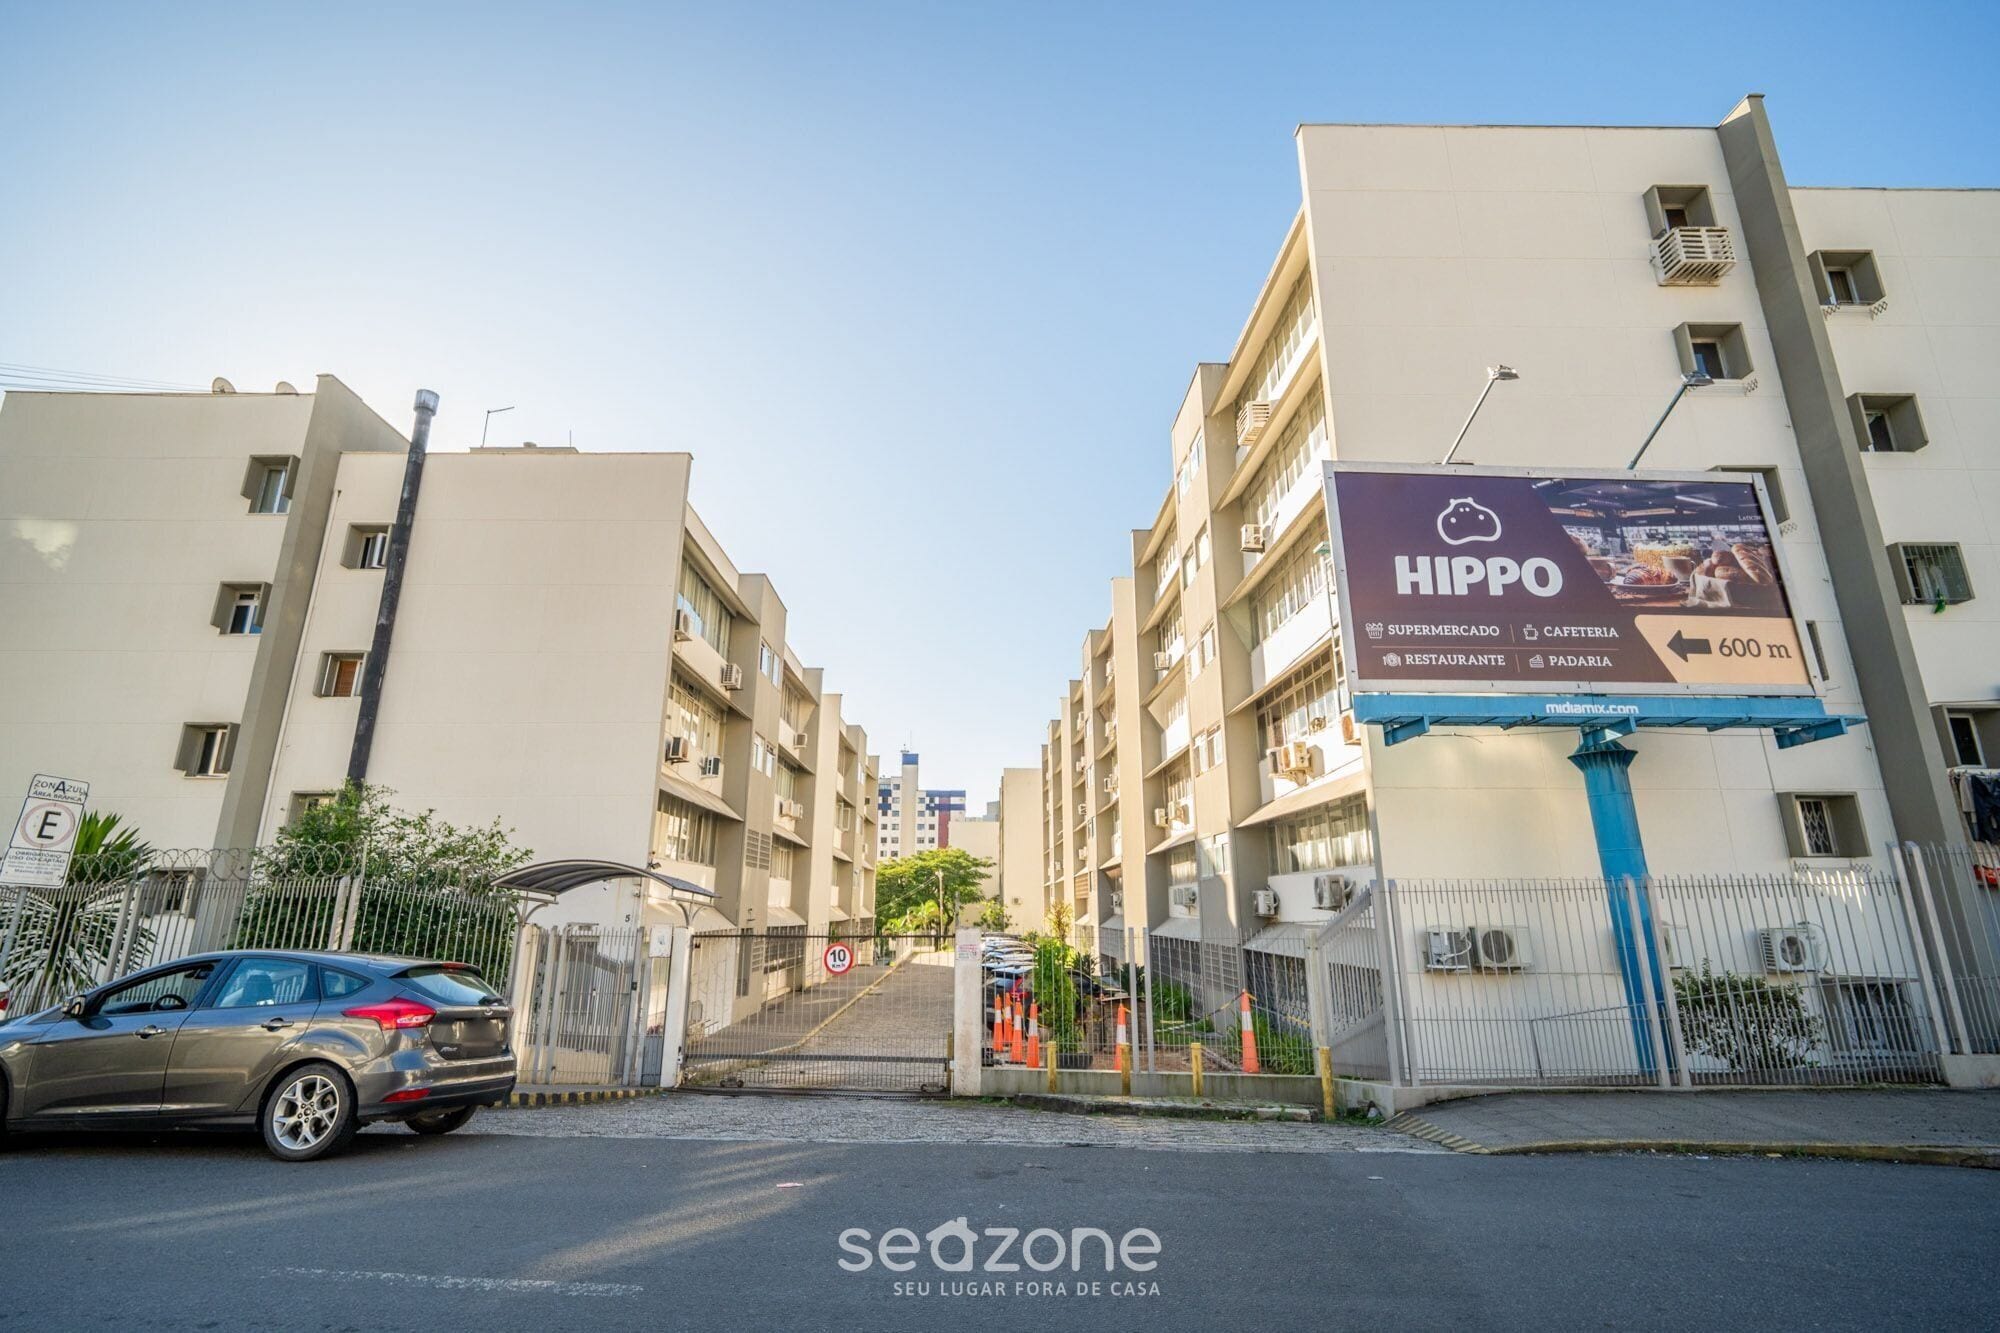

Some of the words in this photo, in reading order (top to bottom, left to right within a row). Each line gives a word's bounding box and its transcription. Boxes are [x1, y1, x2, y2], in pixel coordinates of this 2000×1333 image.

[1394, 555, 1563, 597] HIPPO
[1388, 624, 1500, 637] SUPERMERCADO
[1543, 626, 1620, 638] CAFETERIA
[1718, 637, 1762, 658] 600
[1766, 642, 1792, 659] m
[1405, 654, 1506, 666] RESTAURANTE
[1549, 655, 1613, 667] PADARIA
[1545, 701, 1640, 715] midiamix.com
[37, 810, 62, 840] E
[625, 914, 631, 922] 5
[830, 948, 847, 962] 10
